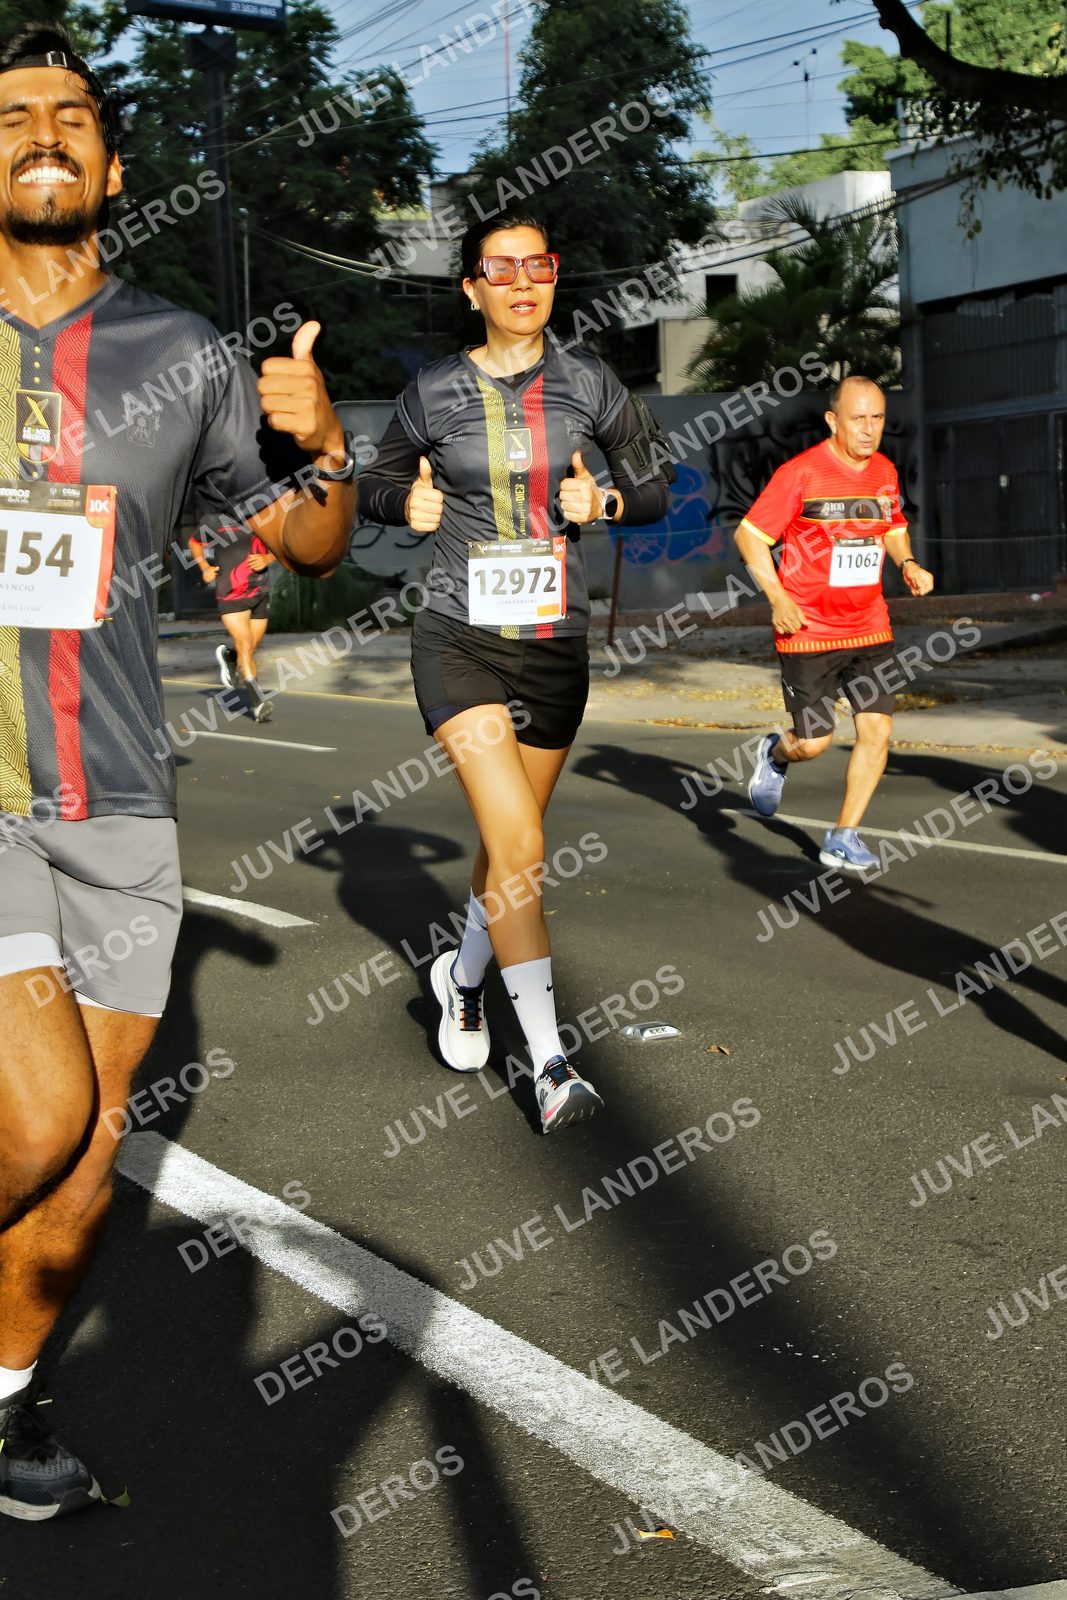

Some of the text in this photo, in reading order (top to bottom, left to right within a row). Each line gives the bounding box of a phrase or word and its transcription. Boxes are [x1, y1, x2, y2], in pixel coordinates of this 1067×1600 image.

[89, 499, 109, 512] 10K
[837, 552, 879, 569] 11062
[474, 566, 556, 595] 12972
